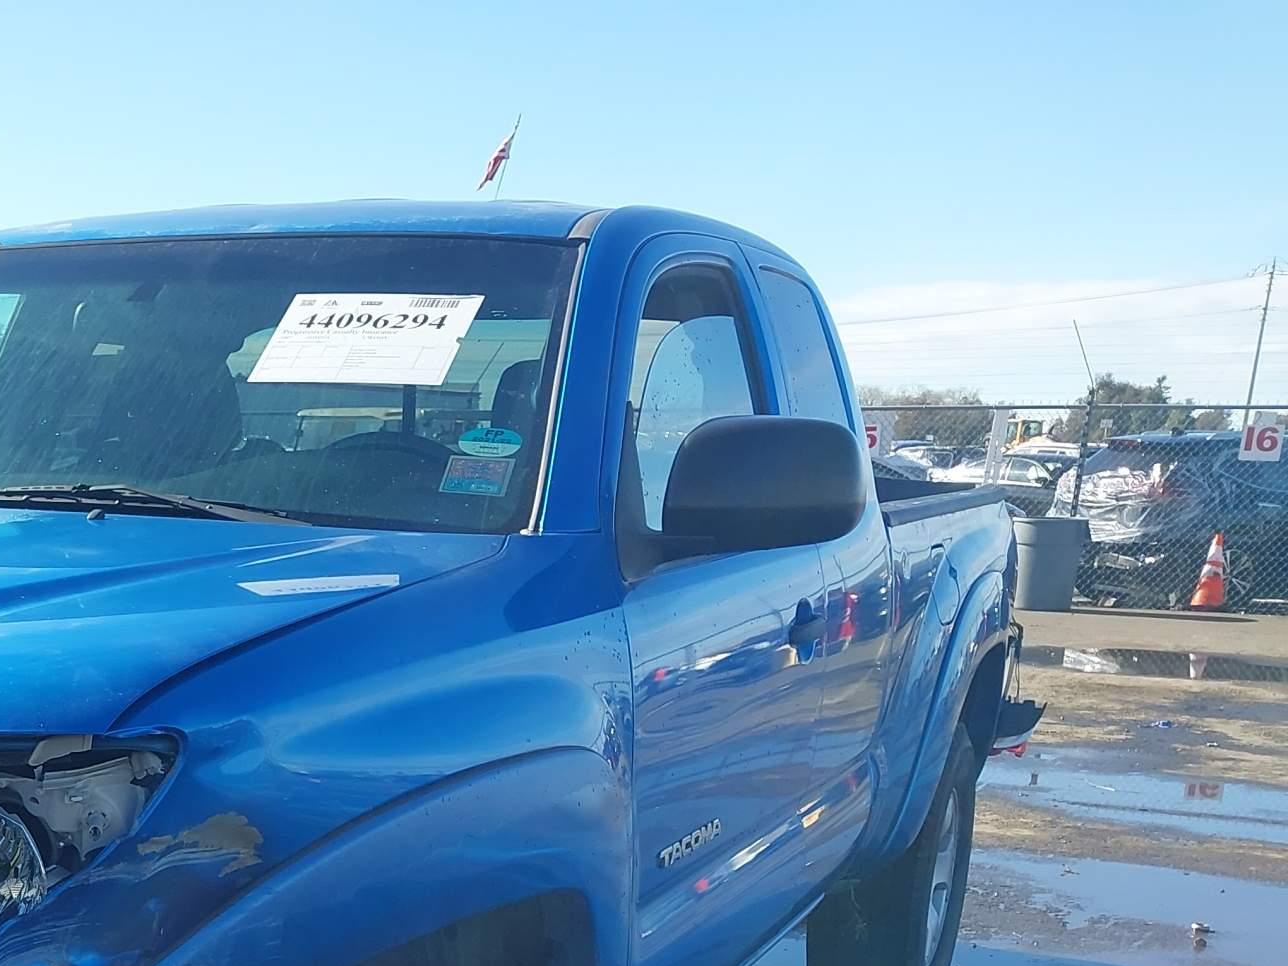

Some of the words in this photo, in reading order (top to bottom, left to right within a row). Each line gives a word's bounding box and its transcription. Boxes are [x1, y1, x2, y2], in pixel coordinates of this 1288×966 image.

[299, 312, 448, 330] 44096294
[1243, 426, 1280, 452] 16
[659, 818, 721, 868] TACOMA
